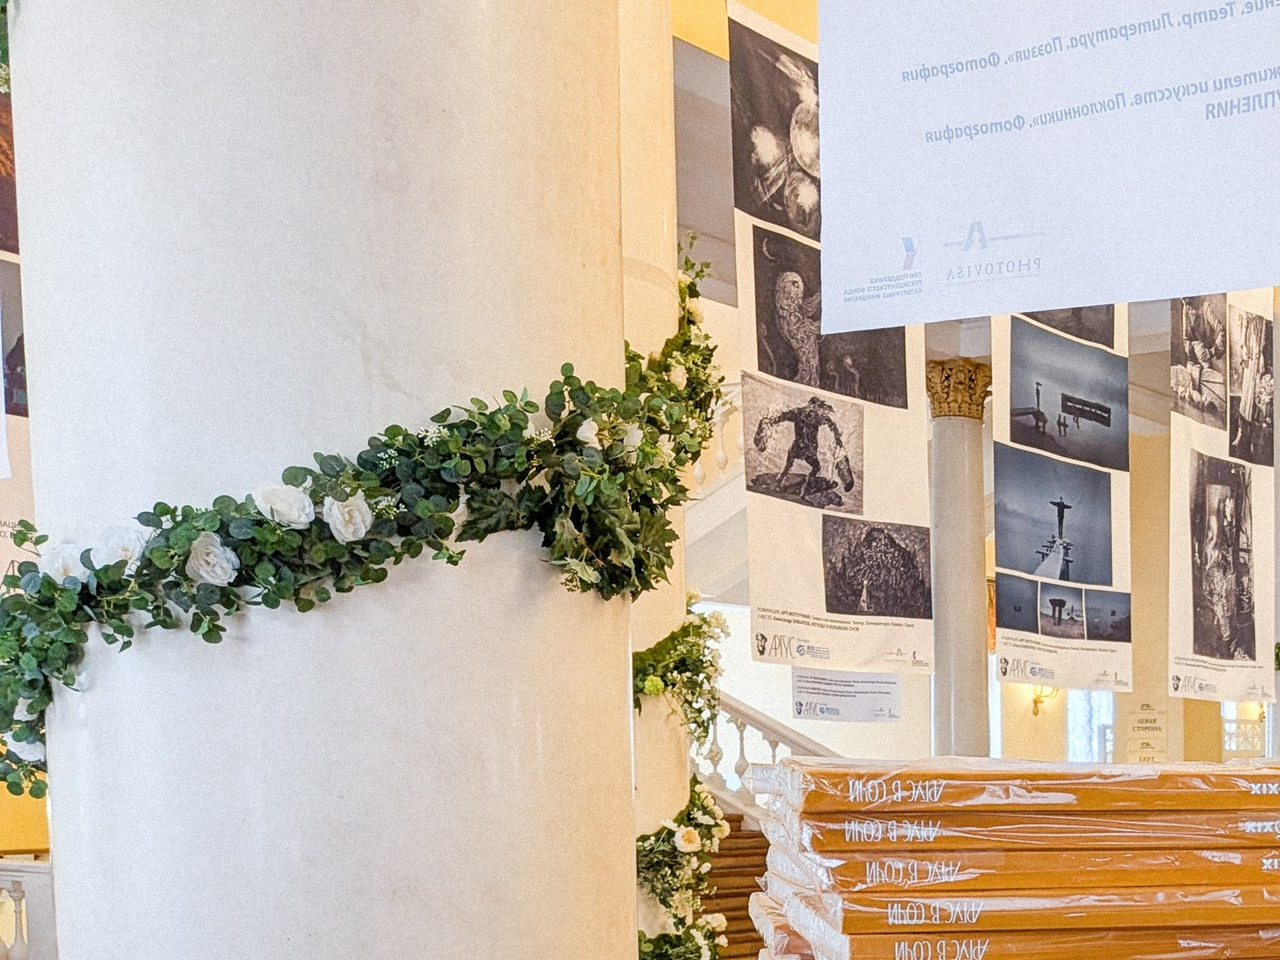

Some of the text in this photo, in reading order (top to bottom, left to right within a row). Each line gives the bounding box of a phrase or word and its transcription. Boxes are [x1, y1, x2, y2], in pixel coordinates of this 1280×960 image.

[892, 780, 901, 802] В
[907, 779, 947, 802] АРГУС
[1250, 783, 1279, 794] XIX
[908, 861, 917, 883] В
[927, 860, 962, 882] АРГУС
[930, 902, 939, 924] В
[945, 901, 984, 924] АРГУС
[951, 939, 989, 960] АРГУС
